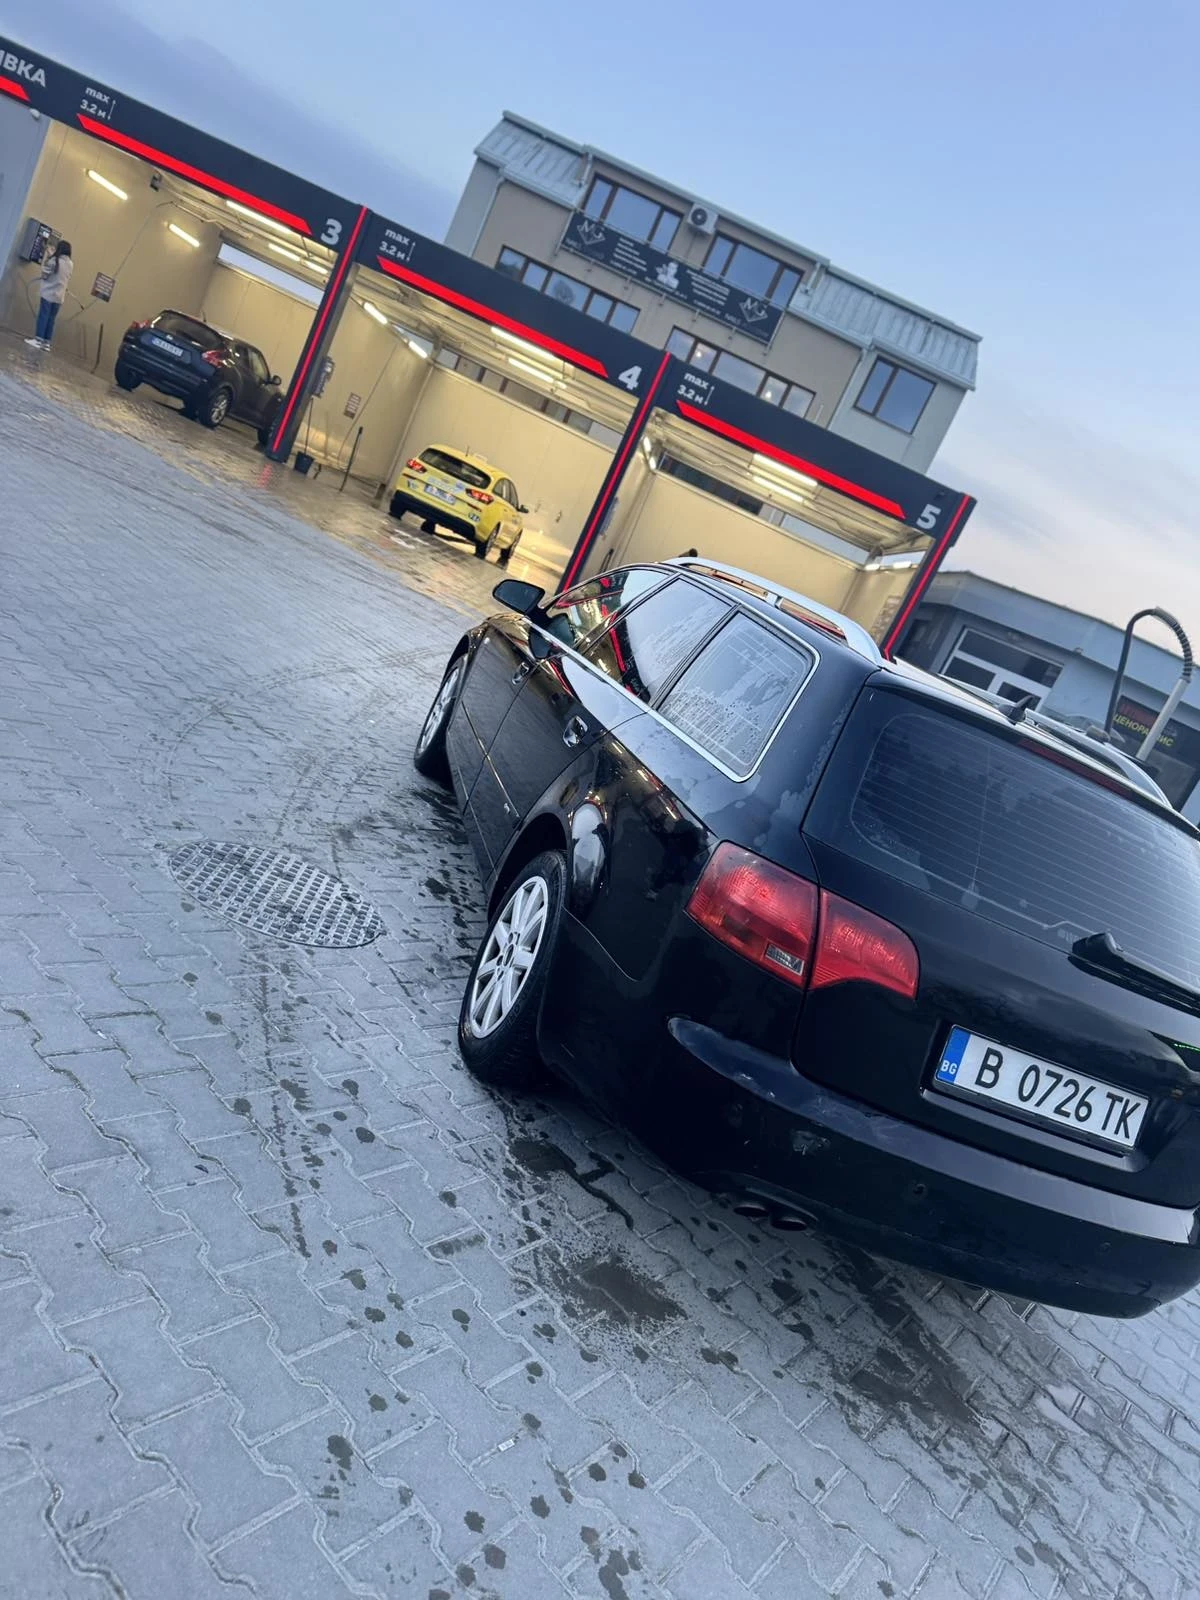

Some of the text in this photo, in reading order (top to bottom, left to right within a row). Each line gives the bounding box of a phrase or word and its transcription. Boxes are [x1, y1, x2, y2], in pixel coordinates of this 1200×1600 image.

[85, 87, 110, 103] max
[80, 99, 98, 114] 3.2
[320, 218, 342, 245] 3
[385, 229, 410, 245] max
[379, 241, 396, 255] 3.2
[618, 365, 642, 390] 4
[684, 372, 710, 390] max
[677, 384, 695, 399] 3.2
[916, 503, 942, 529] 5
[1113, 713, 1174, 746] ЦЕНОРАИС
[940, 1059, 958, 1075] BG
[975, 1047, 1141, 1139] B 0726 TK
